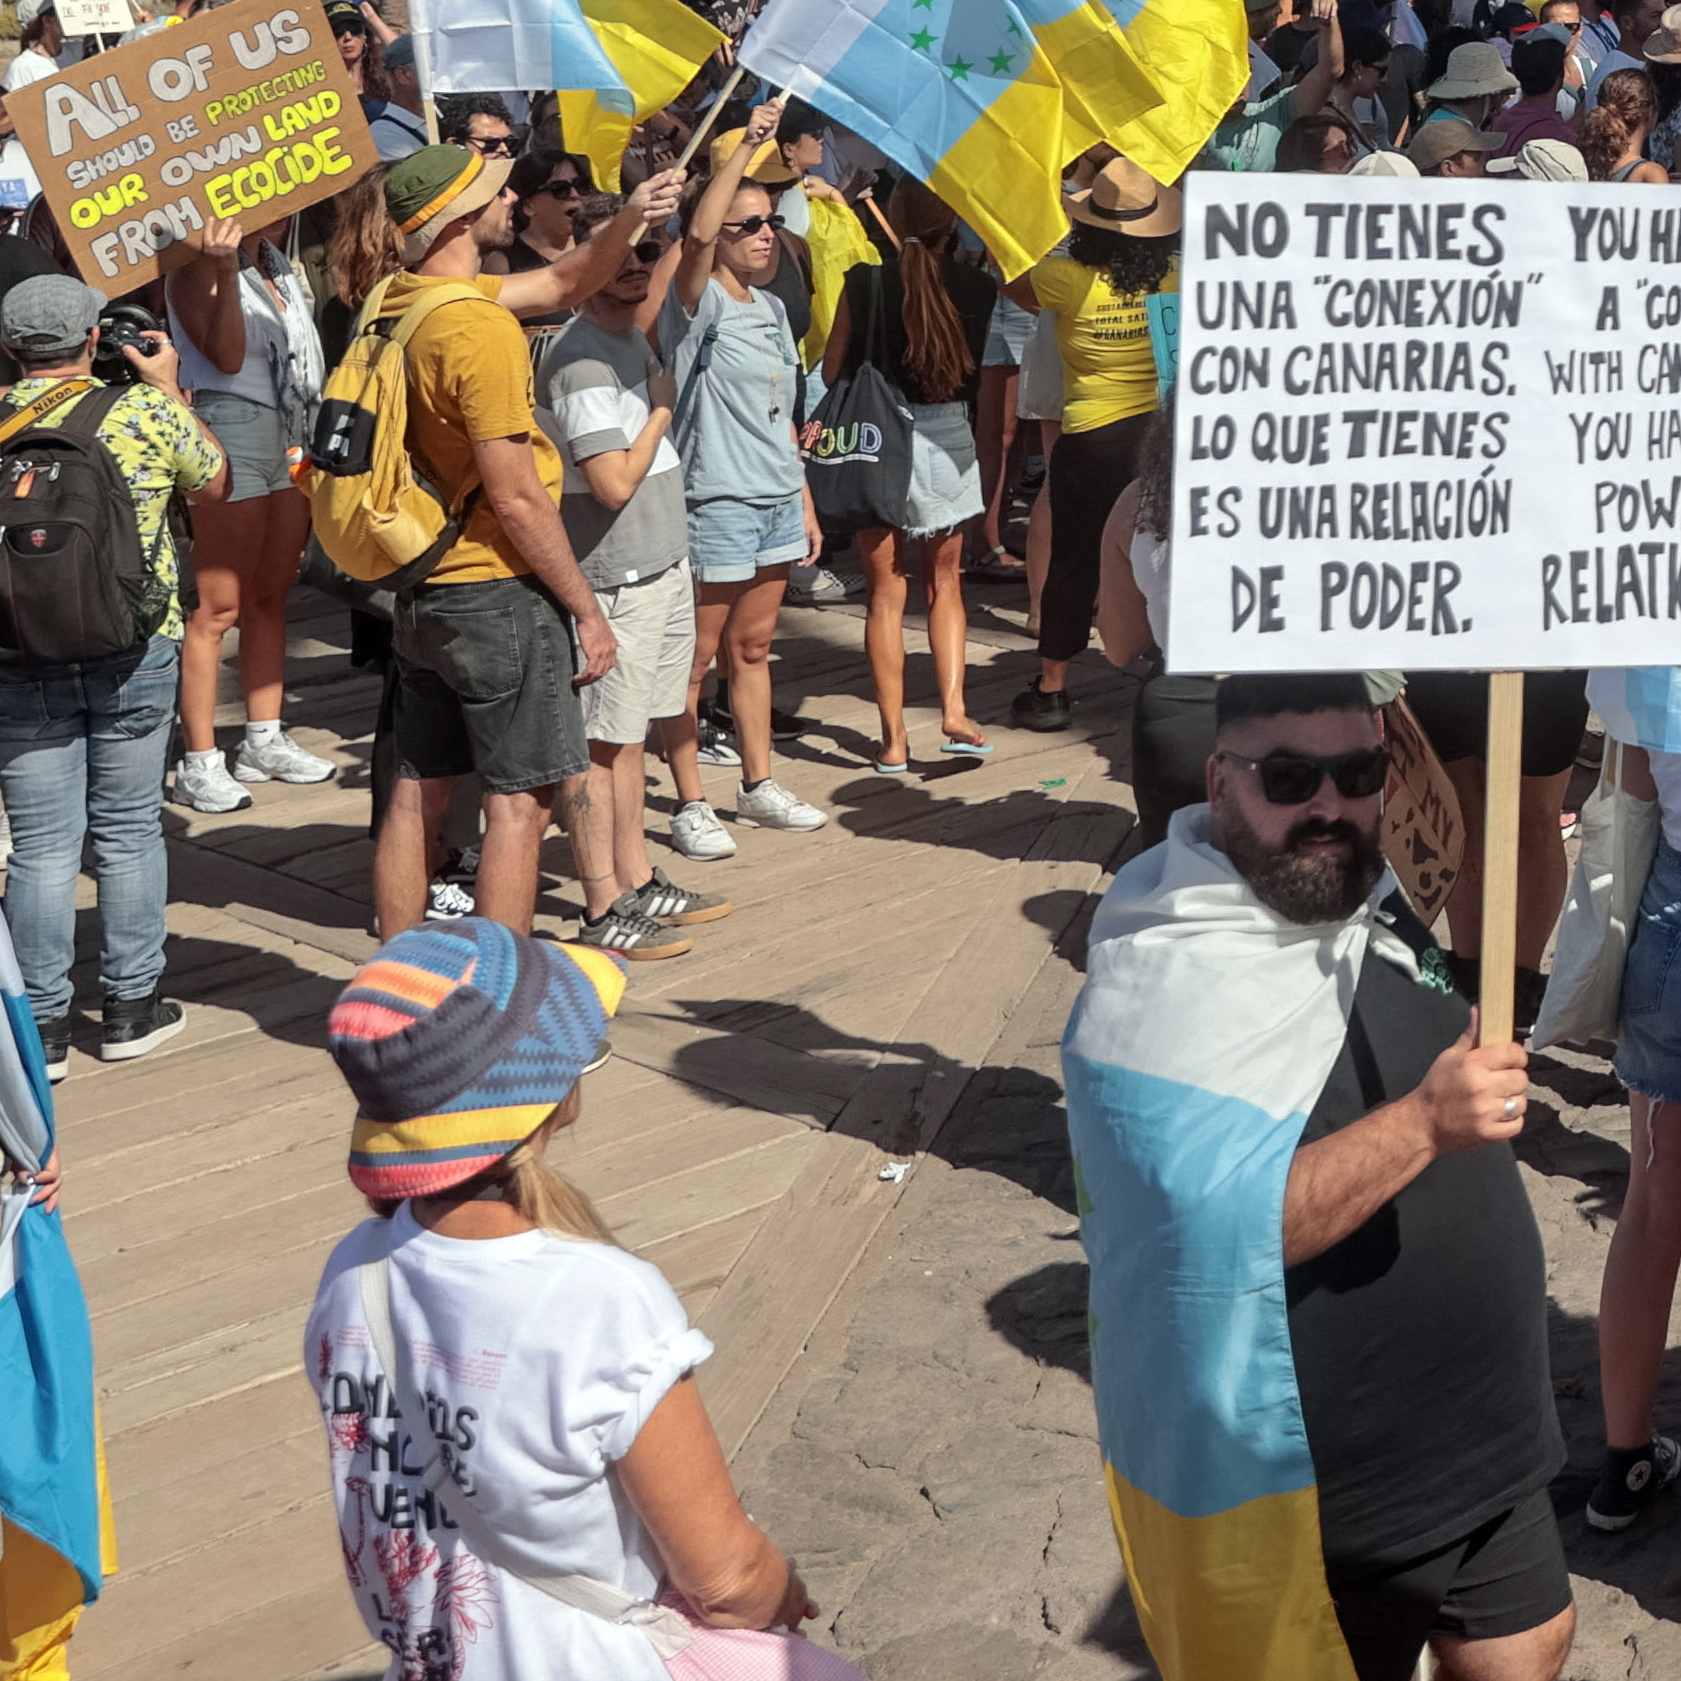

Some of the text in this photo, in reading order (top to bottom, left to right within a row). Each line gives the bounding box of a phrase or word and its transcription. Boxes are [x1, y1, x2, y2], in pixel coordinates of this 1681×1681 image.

[43, 9, 312, 157] ALL OF US
[65, 60, 327, 190] SHOULD BE PROTECTING
[70, 90, 342, 229] OUR OWN LAND
[89, 196, 205, 278] FROM
[1204, 201, 1506, 266] NO TIENES
[1567, 206, 1640, 262] YOU
[1095, 316, 1123, 324] TOTAL
[1197, 280, 1298, 330] UNA
[1595, 285, 1621, 331] A
[1190, 339, 1517, 396] CON CANARIAS.
[1544, 349, 1624, 395] WITH
[32, 386, 73, 415] Nikon
[1190, 409, 1511, 466] LO QUE TIENES
[1568, 411, 1633, 464] YOU
[1189, 464, 1513, 541] ES UNA RELACIÓN
[1231, 560, 1473, 636] DE PODER.
